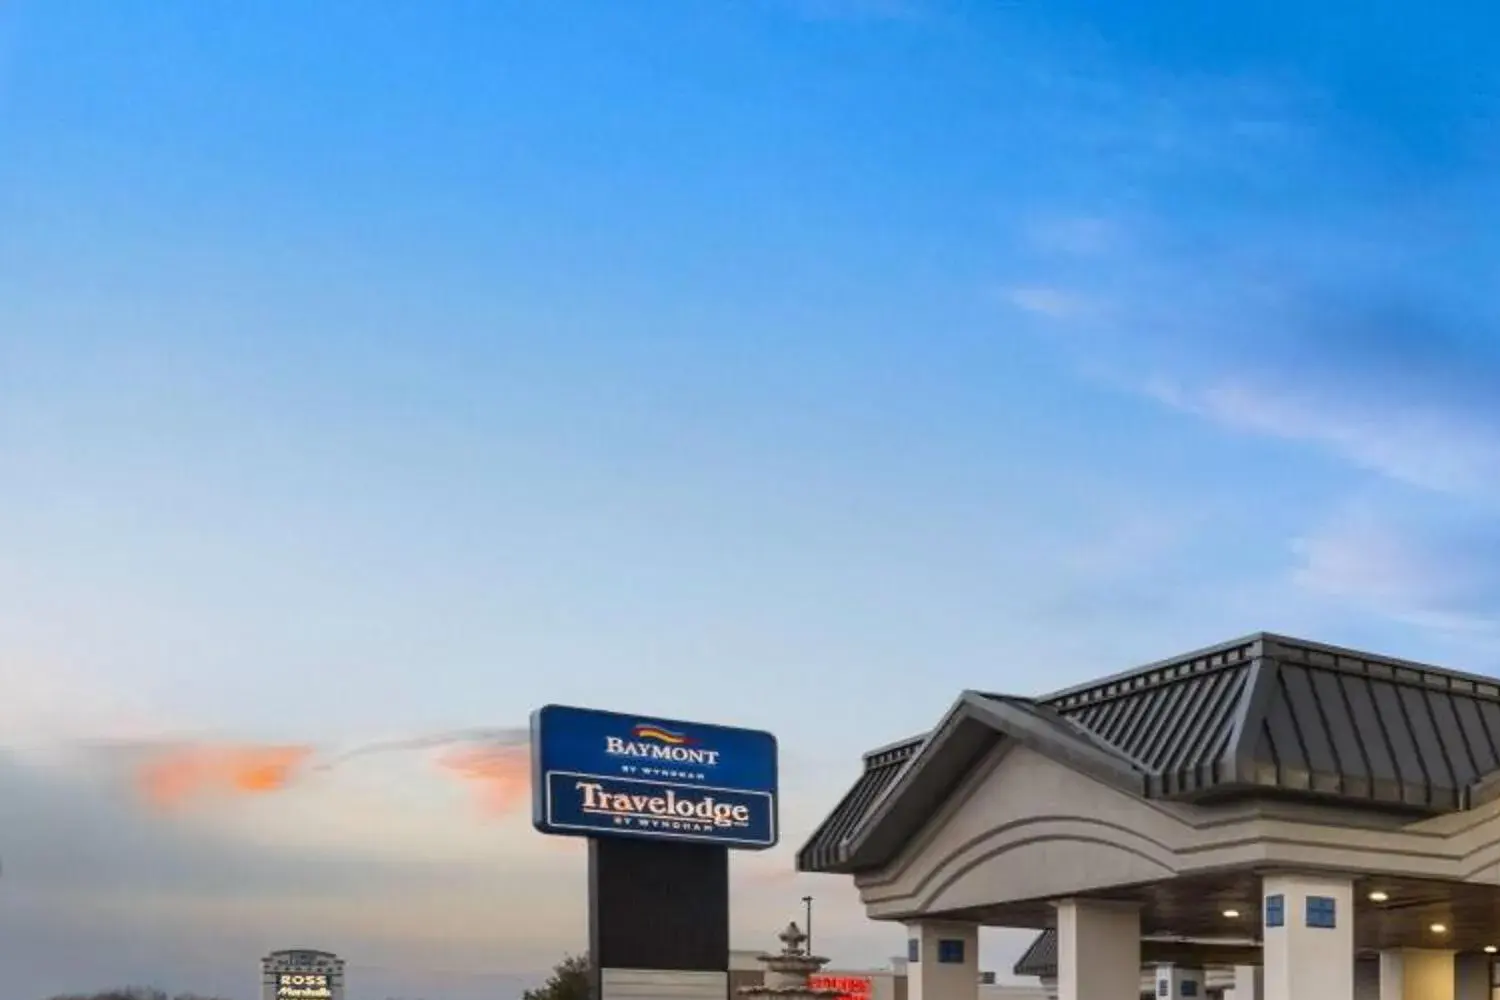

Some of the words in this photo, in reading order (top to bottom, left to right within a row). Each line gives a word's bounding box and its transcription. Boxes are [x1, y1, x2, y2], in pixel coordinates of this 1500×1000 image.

[606, 736, 719, 765] BAYMONT
[621, 764, 637, 773] BY
[642, 766, 704, 780] WYNDHAM
[576, 781, 749, 827] Travelodge
[613, 816, 632, 825] BY
[639, 818, 713, 832] WYNDHAM
[281, 975, 327, 985] ROSS
